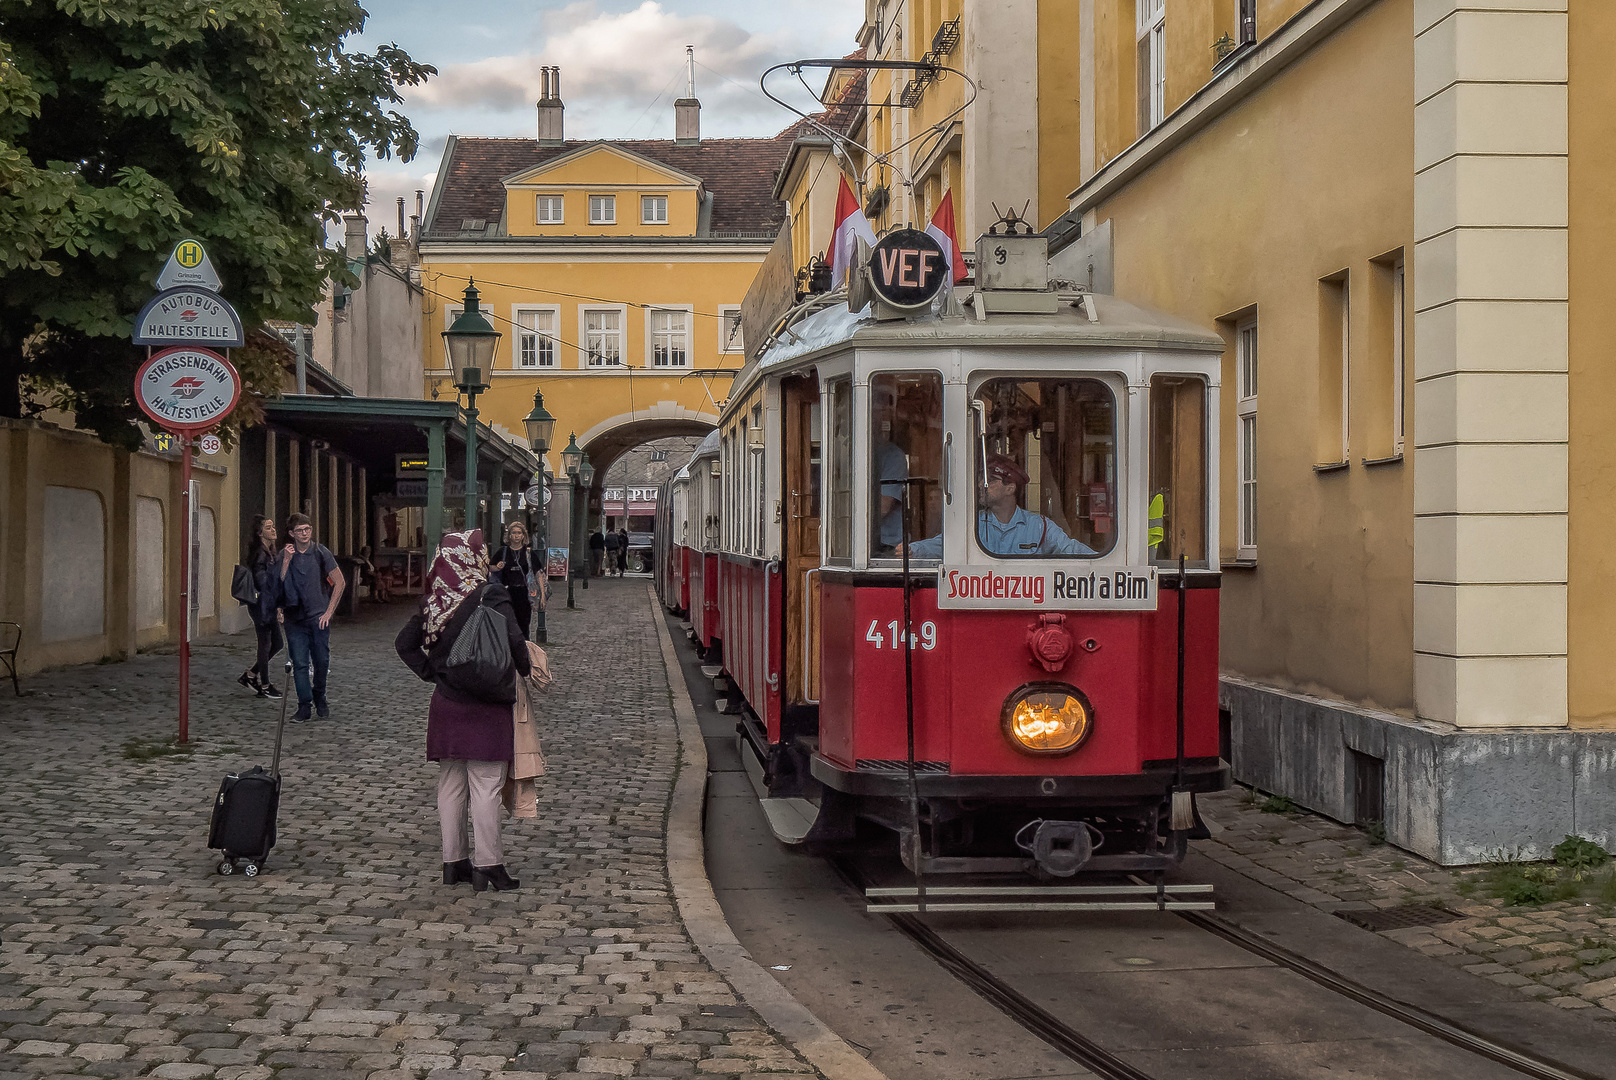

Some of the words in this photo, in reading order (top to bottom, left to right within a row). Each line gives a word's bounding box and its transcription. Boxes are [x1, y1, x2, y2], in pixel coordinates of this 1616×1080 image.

[182, 245, 197, 264] H
[177, 272, 202, 280] Grinzing
[879, 248, 940, 288] VEF
[160, 295, 220, 316] AUTOBUS
[148, 324, 229, 338] HALTESTELLE
[147, 355, 229, 384] STRASSENBAHN
[150, 395, 225, 419] HALTESTELLE
[202, 439, 220, 451] 38
[947, 570, 1045, 604] Sonderzug
[1053, 571, 1096, 599] Rent
[1099, 576, 1111, 599] a
[1114, 571, 1149, 599] Bim
[866, 619, 938, 651] 4149
